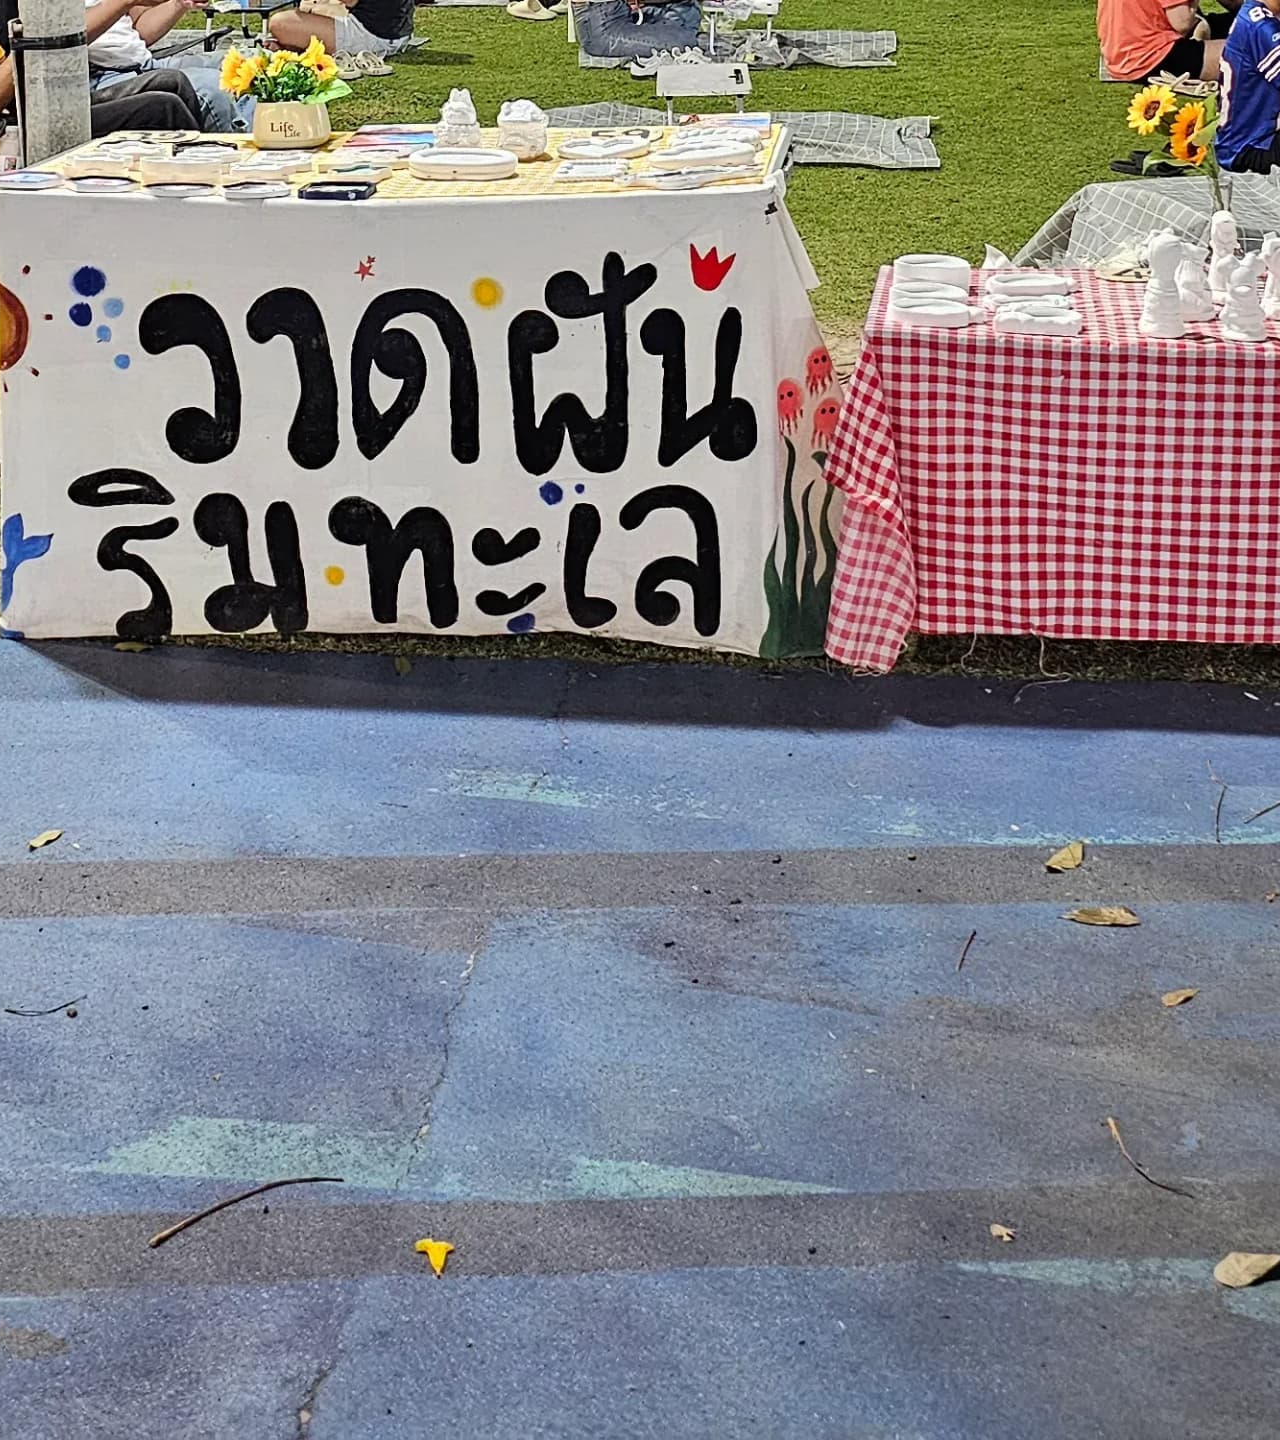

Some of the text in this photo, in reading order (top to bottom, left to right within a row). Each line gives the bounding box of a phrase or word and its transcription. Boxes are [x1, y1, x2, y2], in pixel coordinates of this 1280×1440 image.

[271, 122, 294, 132] Life
[138, 250, 758, 475] วาดฝัน
[67, 467, 722, 637] ริมทะเล
